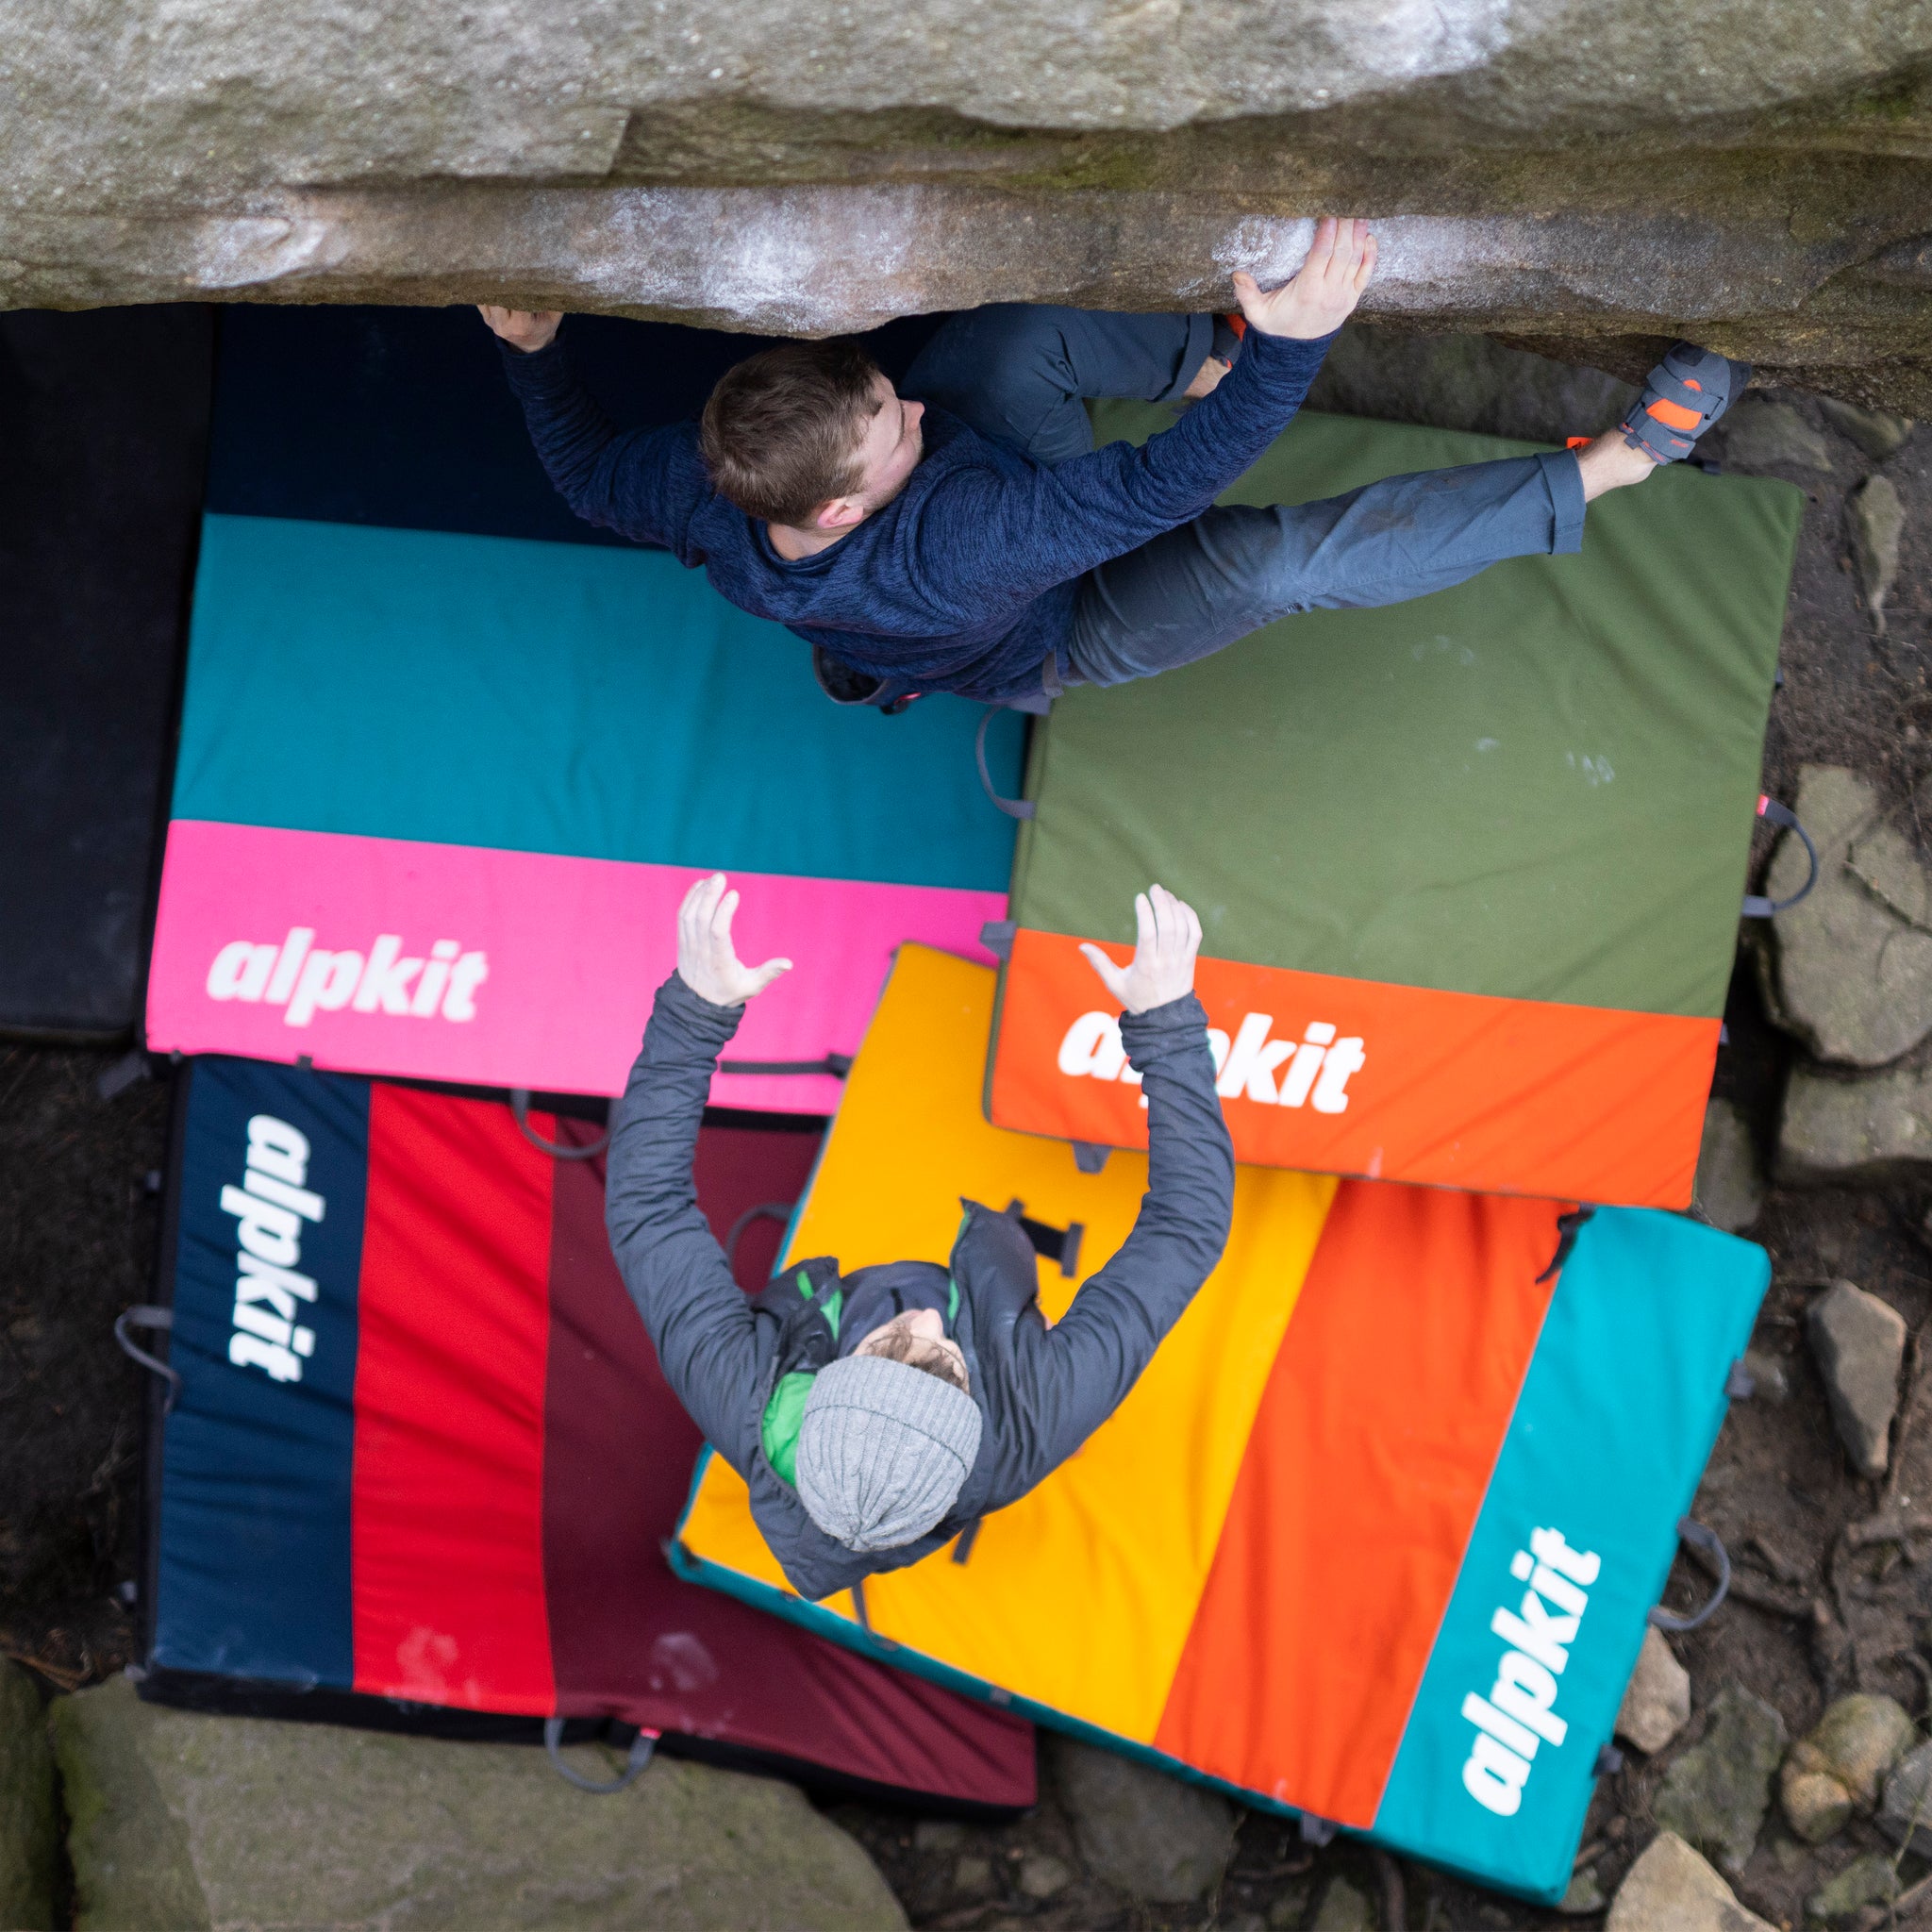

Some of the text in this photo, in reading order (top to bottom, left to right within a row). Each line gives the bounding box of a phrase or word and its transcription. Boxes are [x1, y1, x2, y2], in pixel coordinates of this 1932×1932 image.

[206, 926, 490, 1027] alpkit
[1058, 1011, 1366, 1114] akit
[220, 1114, 325, 1382] alpkit
[1461, 1525, 1601, 1817] alpkit
